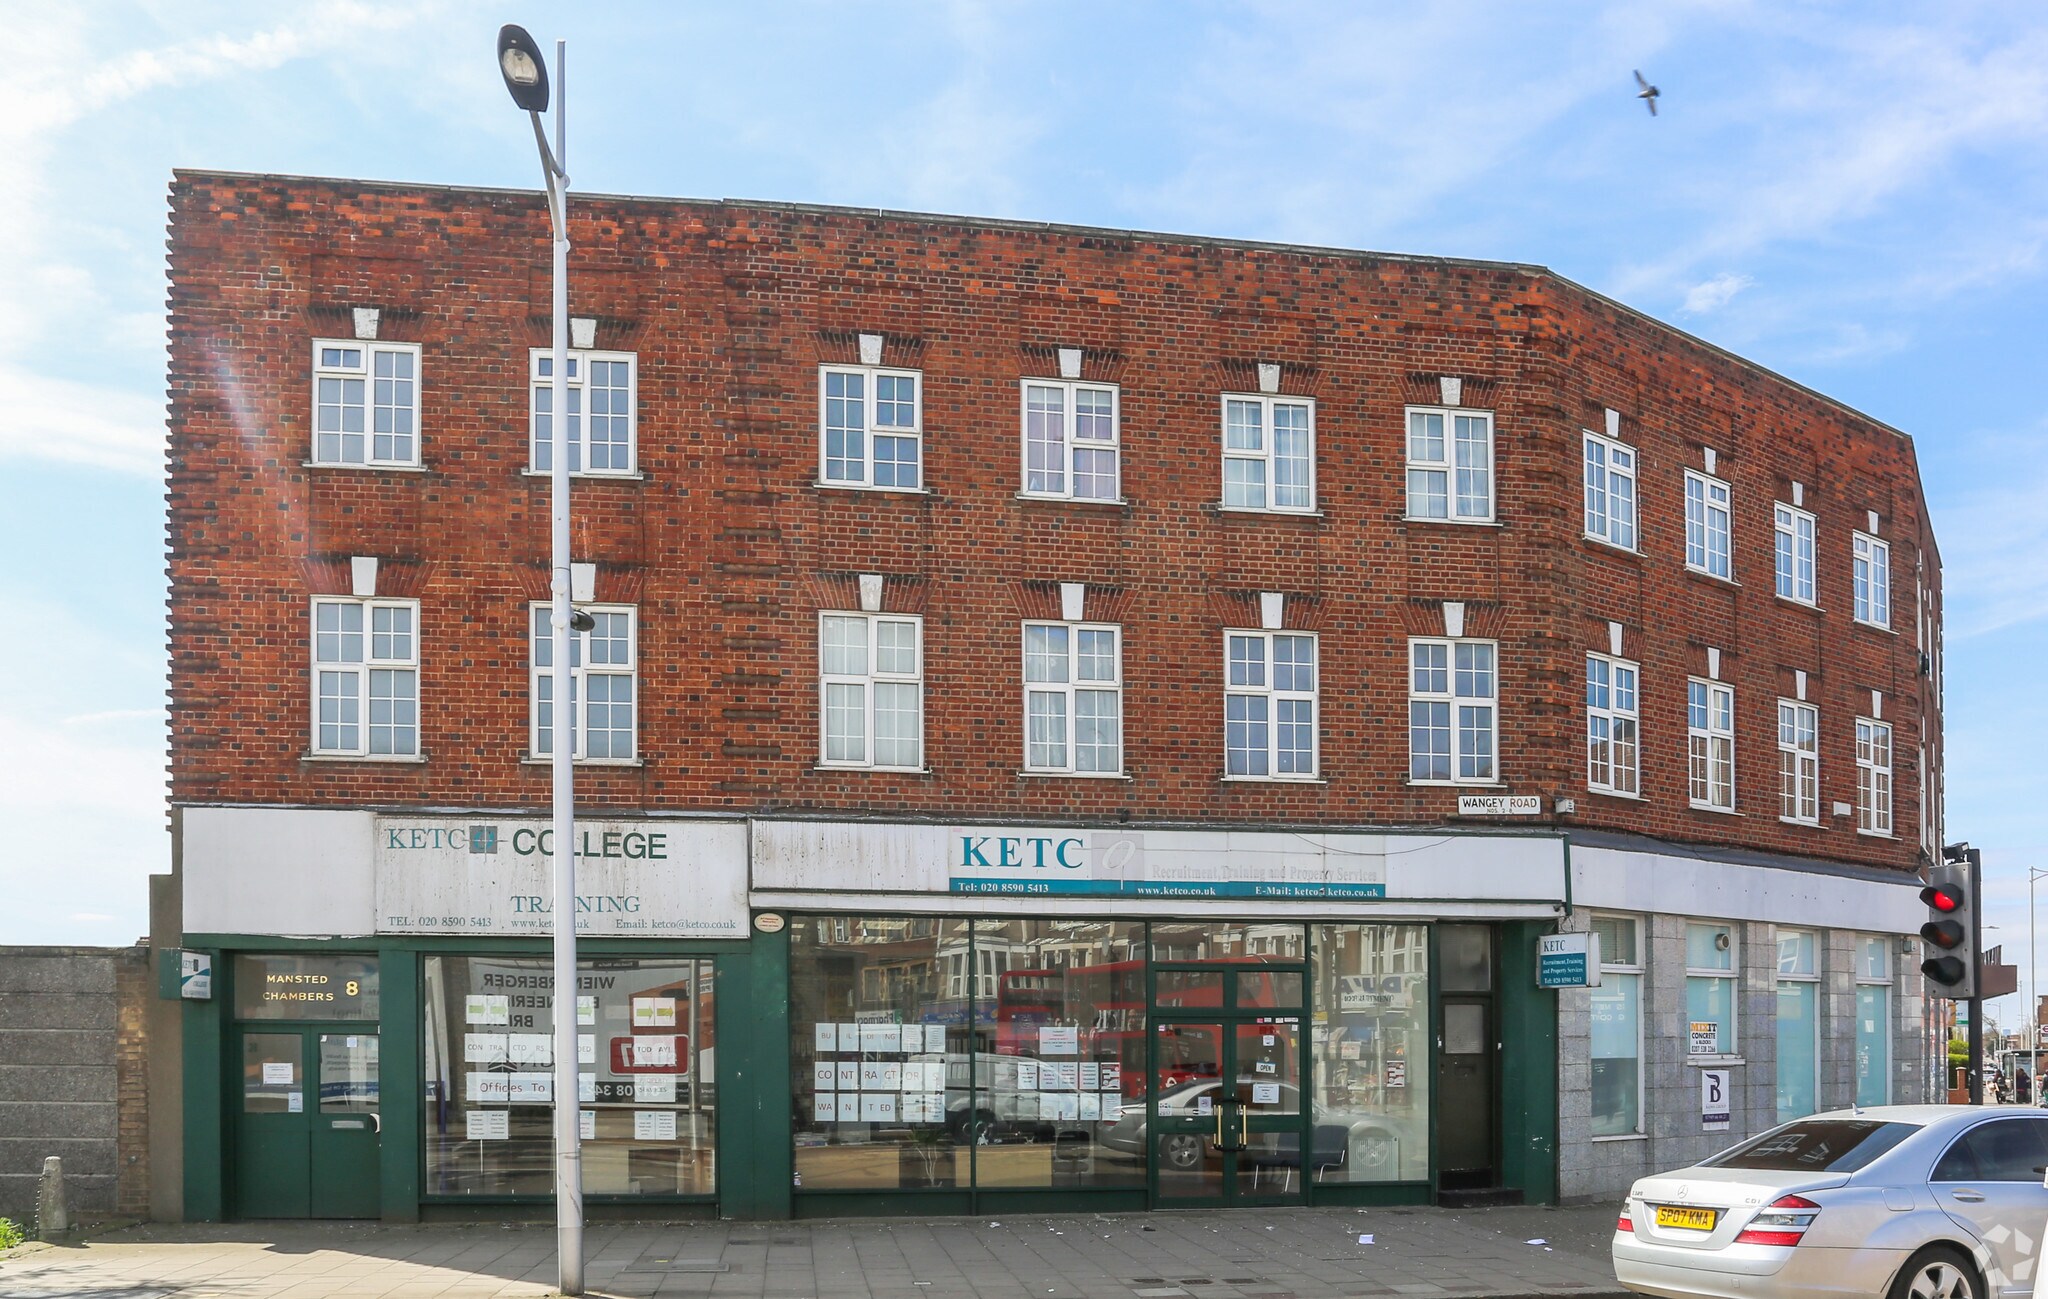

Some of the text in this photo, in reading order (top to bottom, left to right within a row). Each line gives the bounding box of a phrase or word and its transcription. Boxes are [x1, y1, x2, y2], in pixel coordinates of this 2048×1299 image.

[1462, 798, 1537, 808] WANGEY ROAD
[513, 828, 668, 860] COLEGE
[1269, 865, 1285, 880] and
[1290, 866, 1334, 883] Property
[1337, 867, 1377, 882] Services
[958, 883, 1049, 893] Tel: 020 8590 5413
[1137, 886, 1216, 896] www.ketco.co.uk
[1255, 886, 1292, 896] E-Mail:
[511, 896, 641, 913] TRNING
[388, 916, 492, 927] TEL: 020 8590 5413
[616, 919, 737, 930] Email: ketco@ketco.co.uk
[266, 975, 359, 996] MANSTED 8
[262, 992, 334, 1001] CHAMBERS
[817, 1071, 832, 1079] CO
[841, 1071, 854, 1079] NT
[864, 1071, 878, 1079] RA
[884, 1071, 897, 1079] CT
[905, 1072, 919, 1080] OR
[531, 1083, 546, 1092] To
[1660, 1209, 1709, 1226] SP07 KMA
